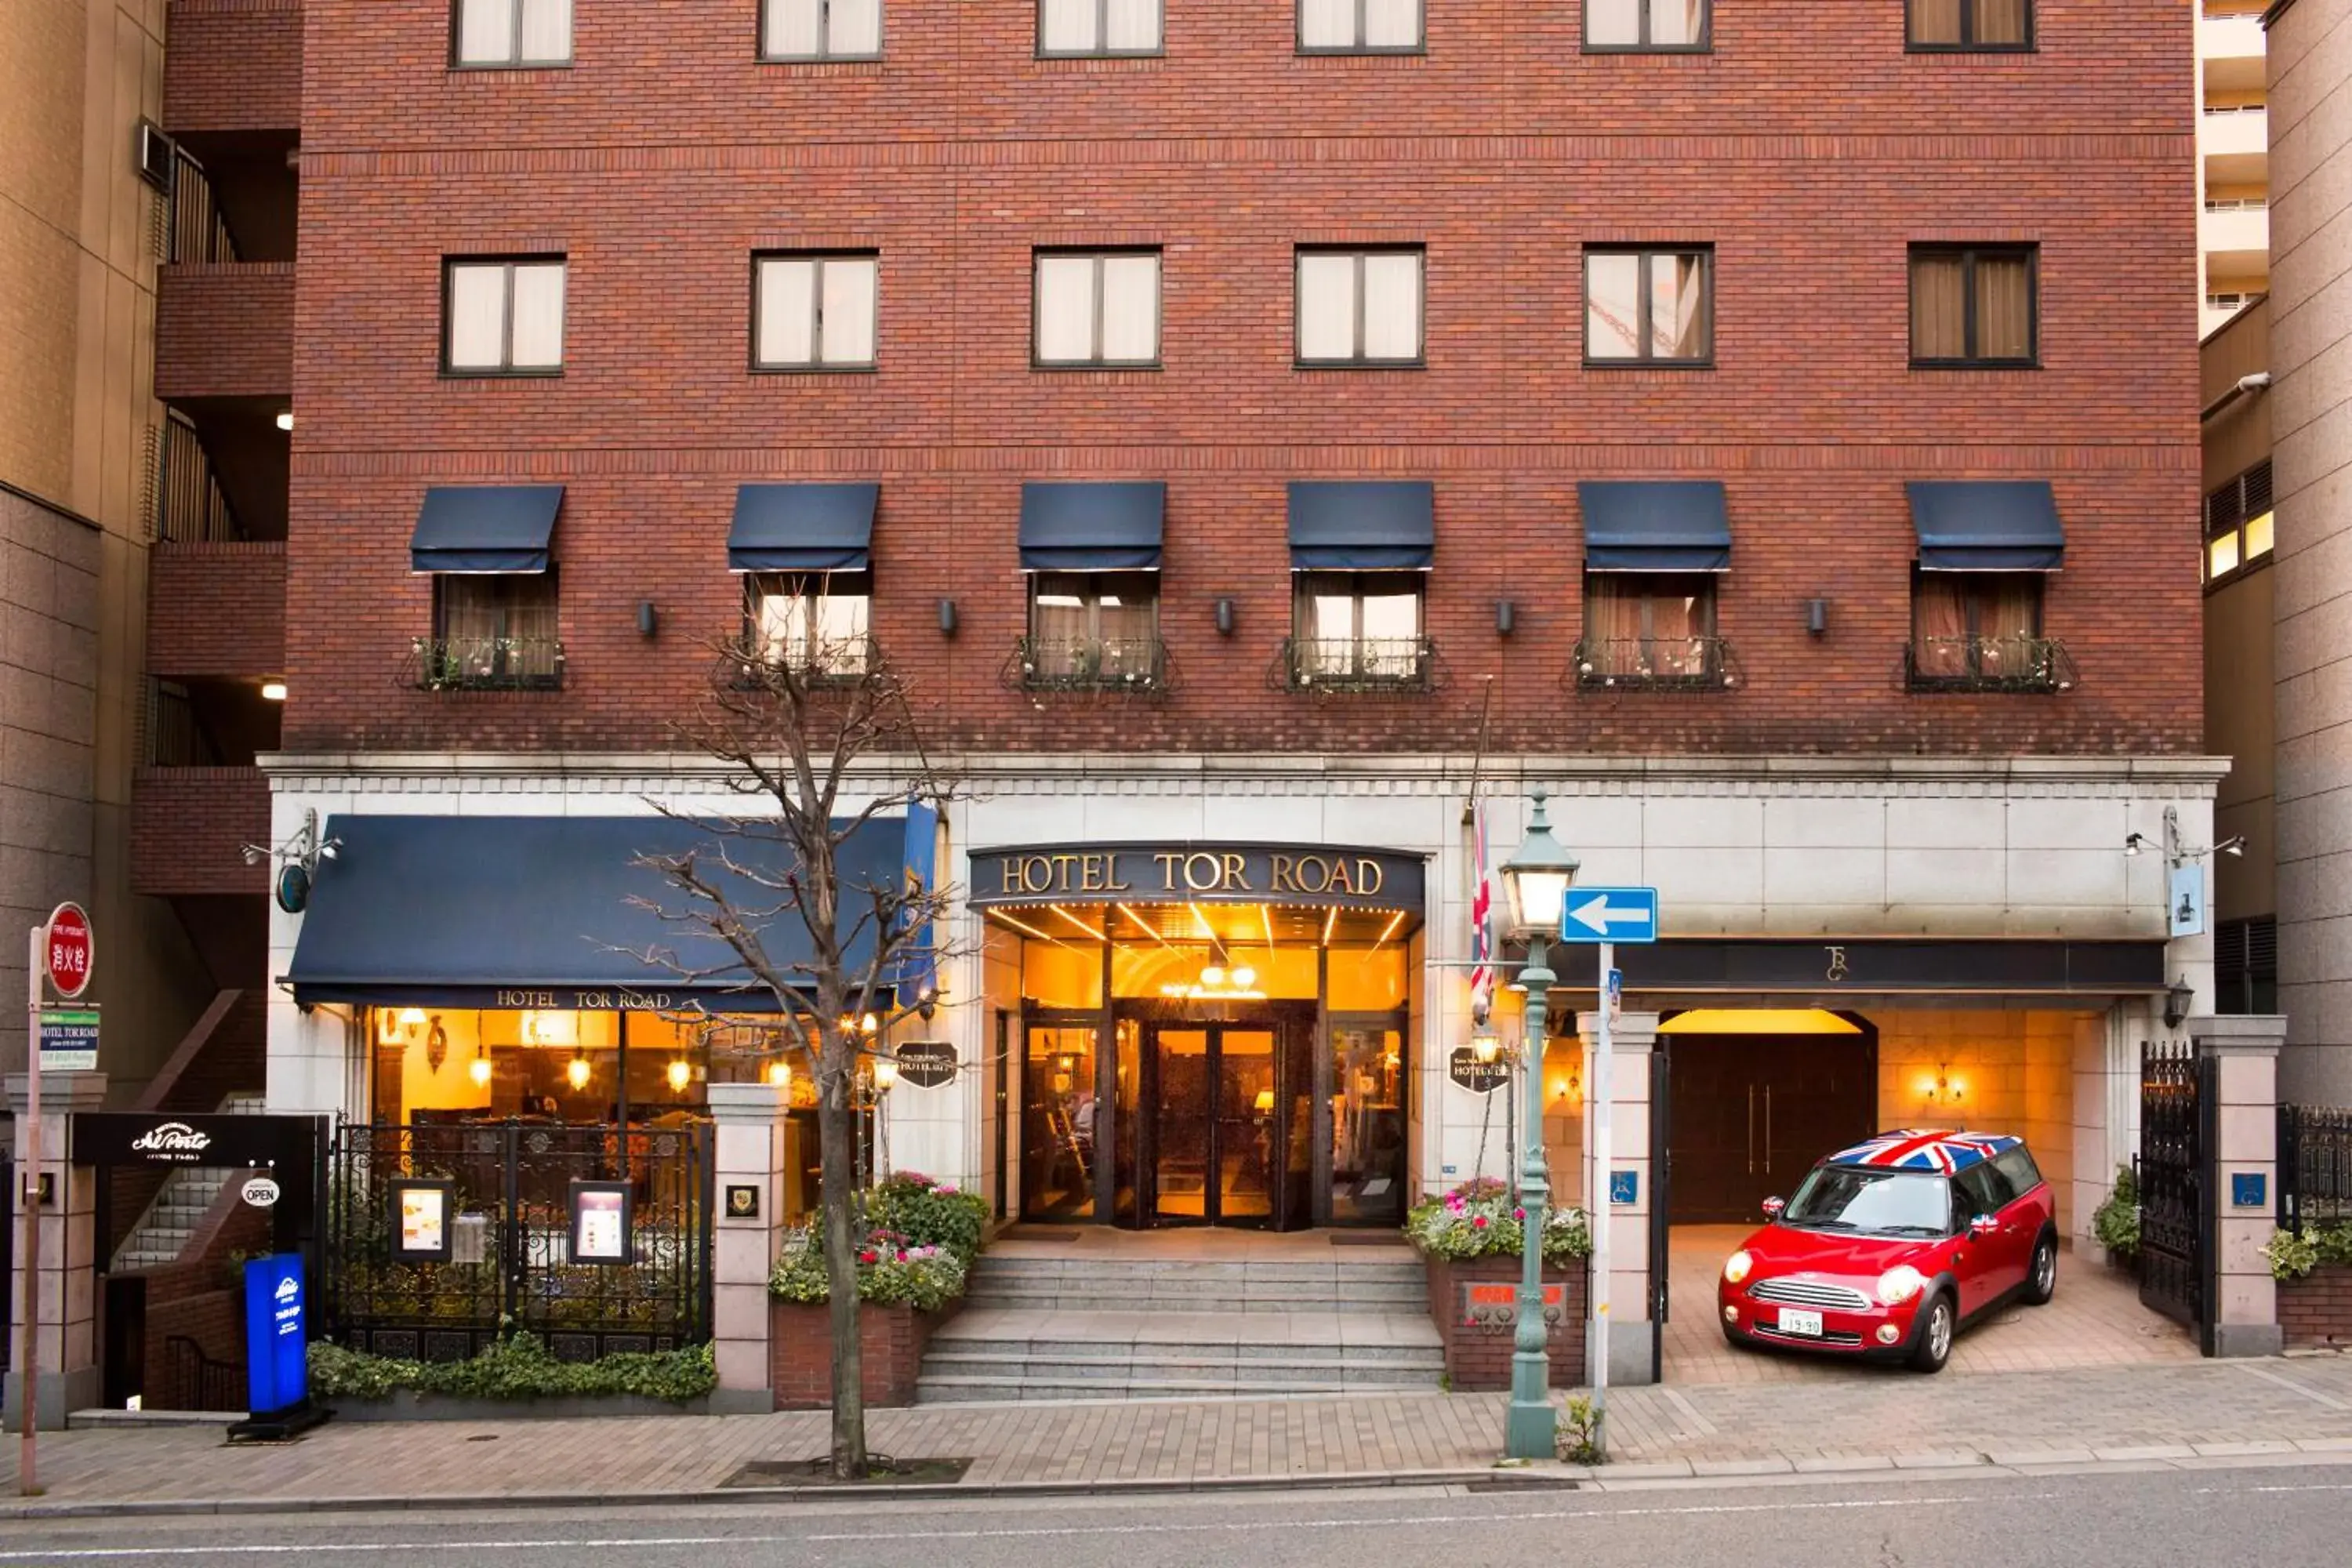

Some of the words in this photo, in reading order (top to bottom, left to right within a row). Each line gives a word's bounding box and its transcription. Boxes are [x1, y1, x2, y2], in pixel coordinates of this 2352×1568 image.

[1002, 854, 1129, 894] HOTEL
[1154, 852, 1253, 891] TOR
[1269, 854, 1382, 895] ROAD
[496, 990, 559, 1007] HOTEL
[574, 992, 612, 1007] TOR
[618, 993, 670, 1009] ROAD
[246, 1189, 274, 1200] OPEN
